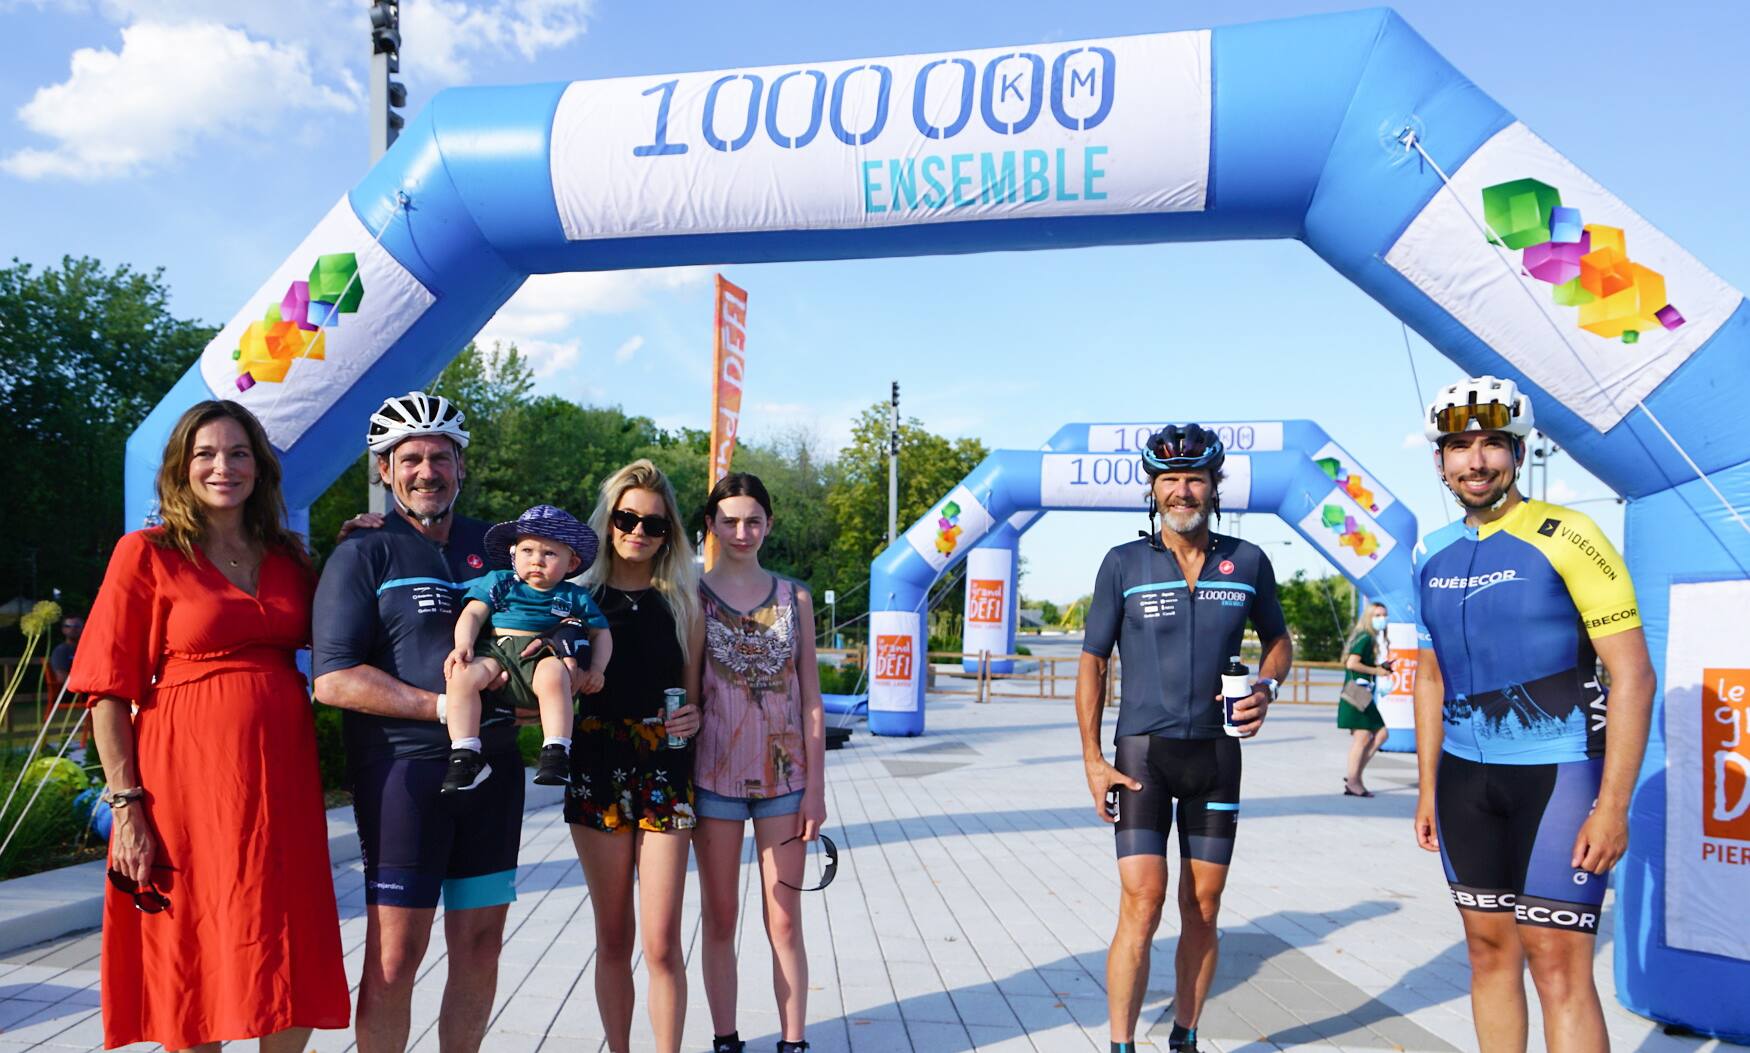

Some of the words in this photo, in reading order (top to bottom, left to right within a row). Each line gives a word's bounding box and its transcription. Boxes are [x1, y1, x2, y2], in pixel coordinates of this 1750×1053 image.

[862, 145, 1108, 214] ENSEMBLE
[1428, 569, 1517, 589] QUÉBECOR
[1561, 526, 1617, 582] VIDÉOTRON
[1583, 675, 1607, 731] TVA
[1718, 678, 1745, 702] le
